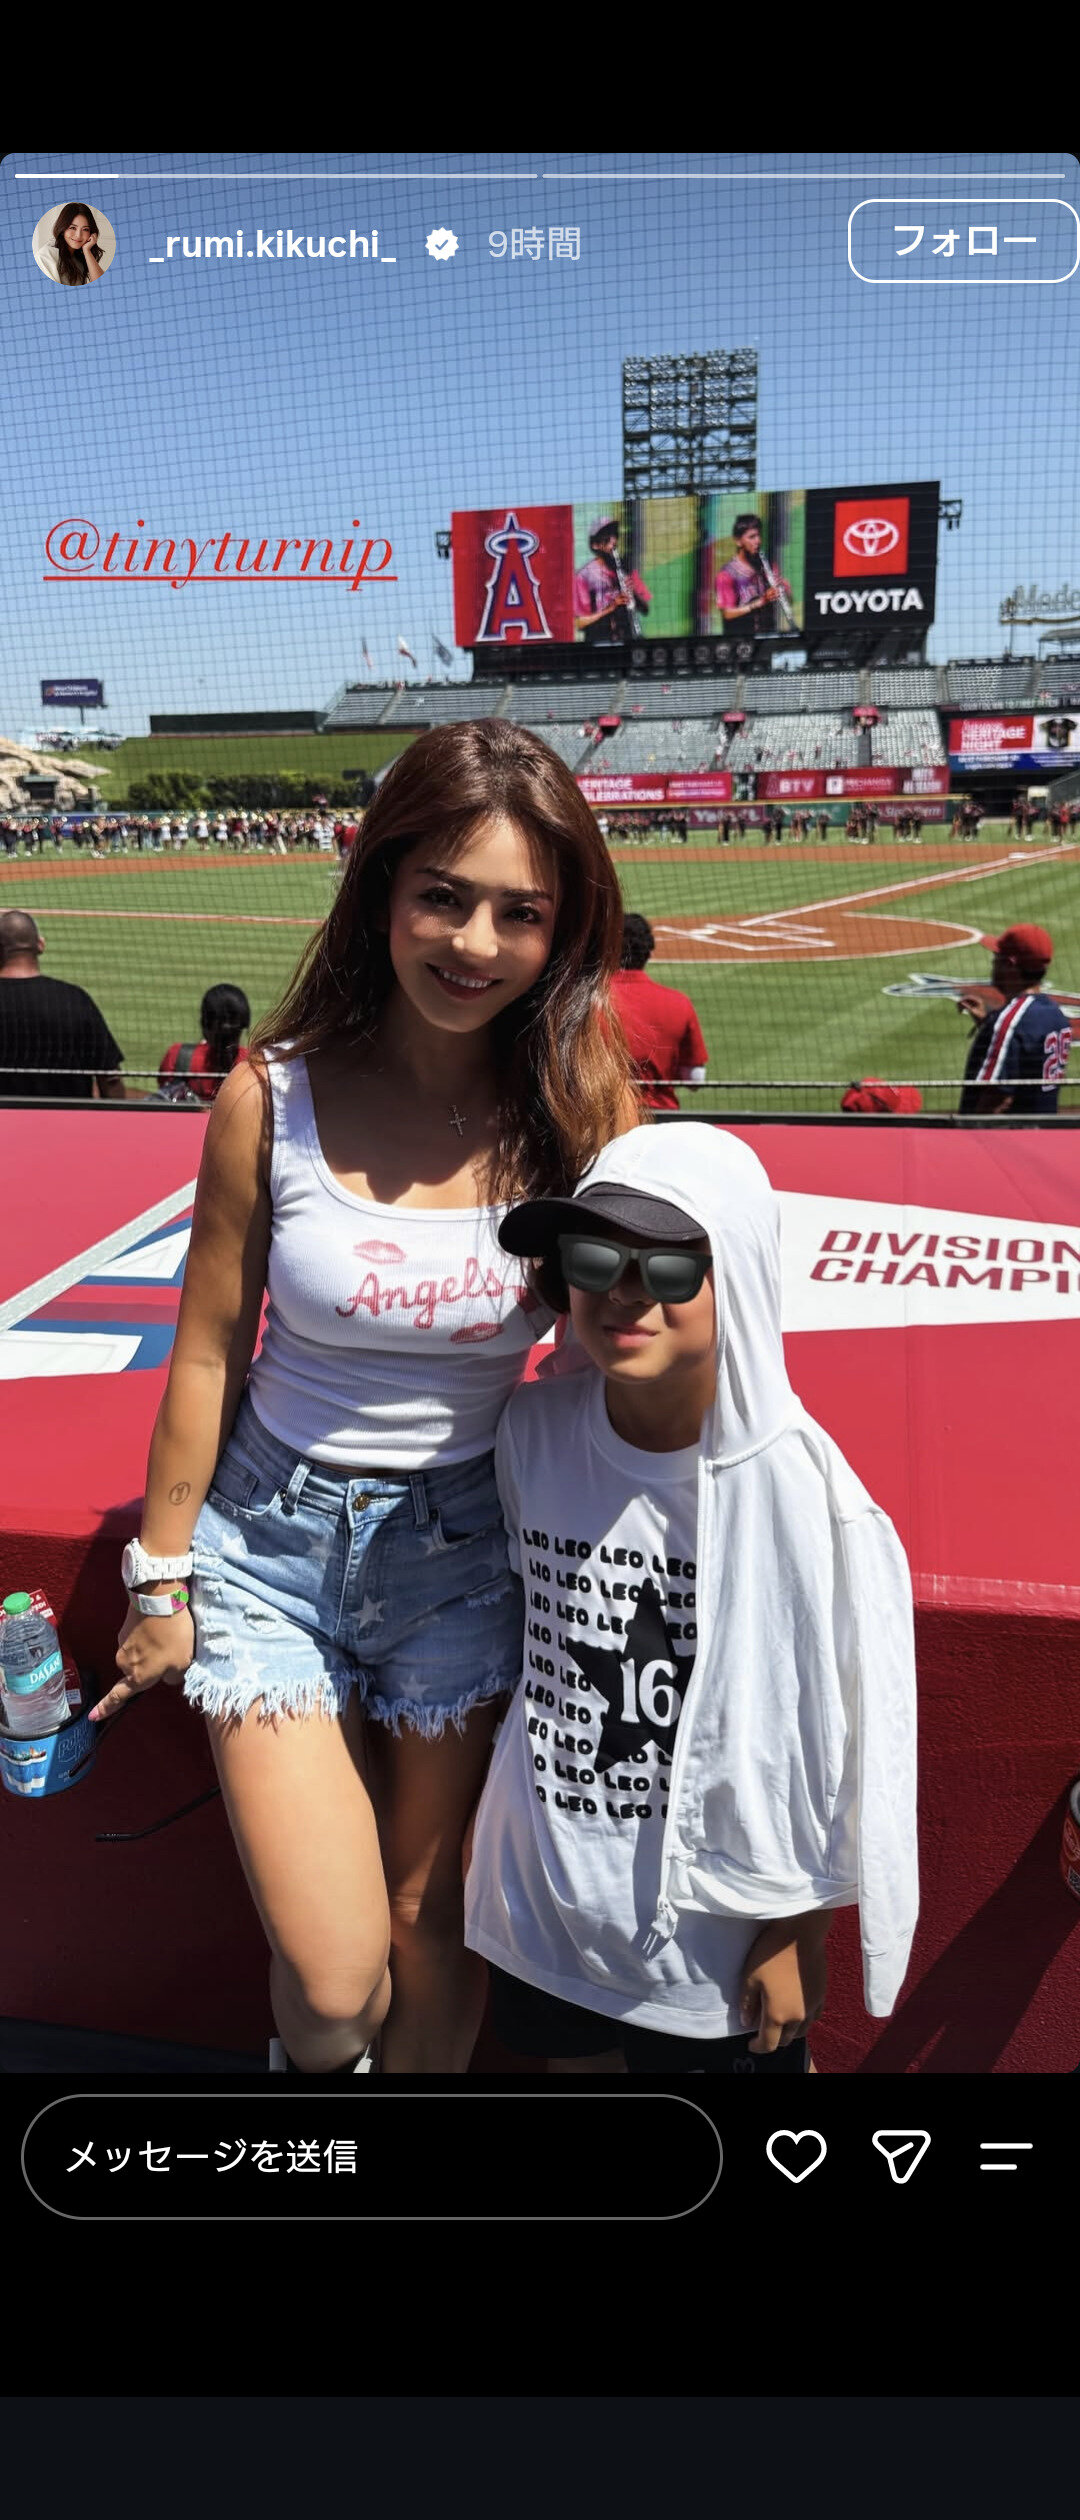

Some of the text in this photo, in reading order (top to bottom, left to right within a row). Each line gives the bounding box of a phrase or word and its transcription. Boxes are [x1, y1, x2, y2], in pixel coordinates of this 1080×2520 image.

[814, 588, 924, 615] TOYOTA
[961, 727, 1026, 741] HERITAGE
[961, 740, 1002, 752] NIGHT
[584, 788, 665, 802] LEBRATIONS
[335, 1257, 502, 1330] Angels
[809, 1258, 1080, 1294] CHAMPI
[522, 1528, 697, 1580] LEO LEO LEO LEO
[556, 1569, 592, 1593] LEO
[600, 1579, 641, 1603] LEO
[528, 1617, 552, 1645] LEO
[556, 1601, 589, 1626] LEO
[667, 1622, 697, 1640] EO
[529, 1649, 592, 1692] LEO LEO
[525, 1679, 592, 1724] LEO LEO
[620, 1657, 681, 1727] 16
[528, 1716, 593, 1755] EO LEO
[554, 1759, 595, 1785] LEO
[604, 1771, 650, 1792] LEO
[554, 1791, 597, 1815] LEO
[606, 1801, 651, 1819] LEO
